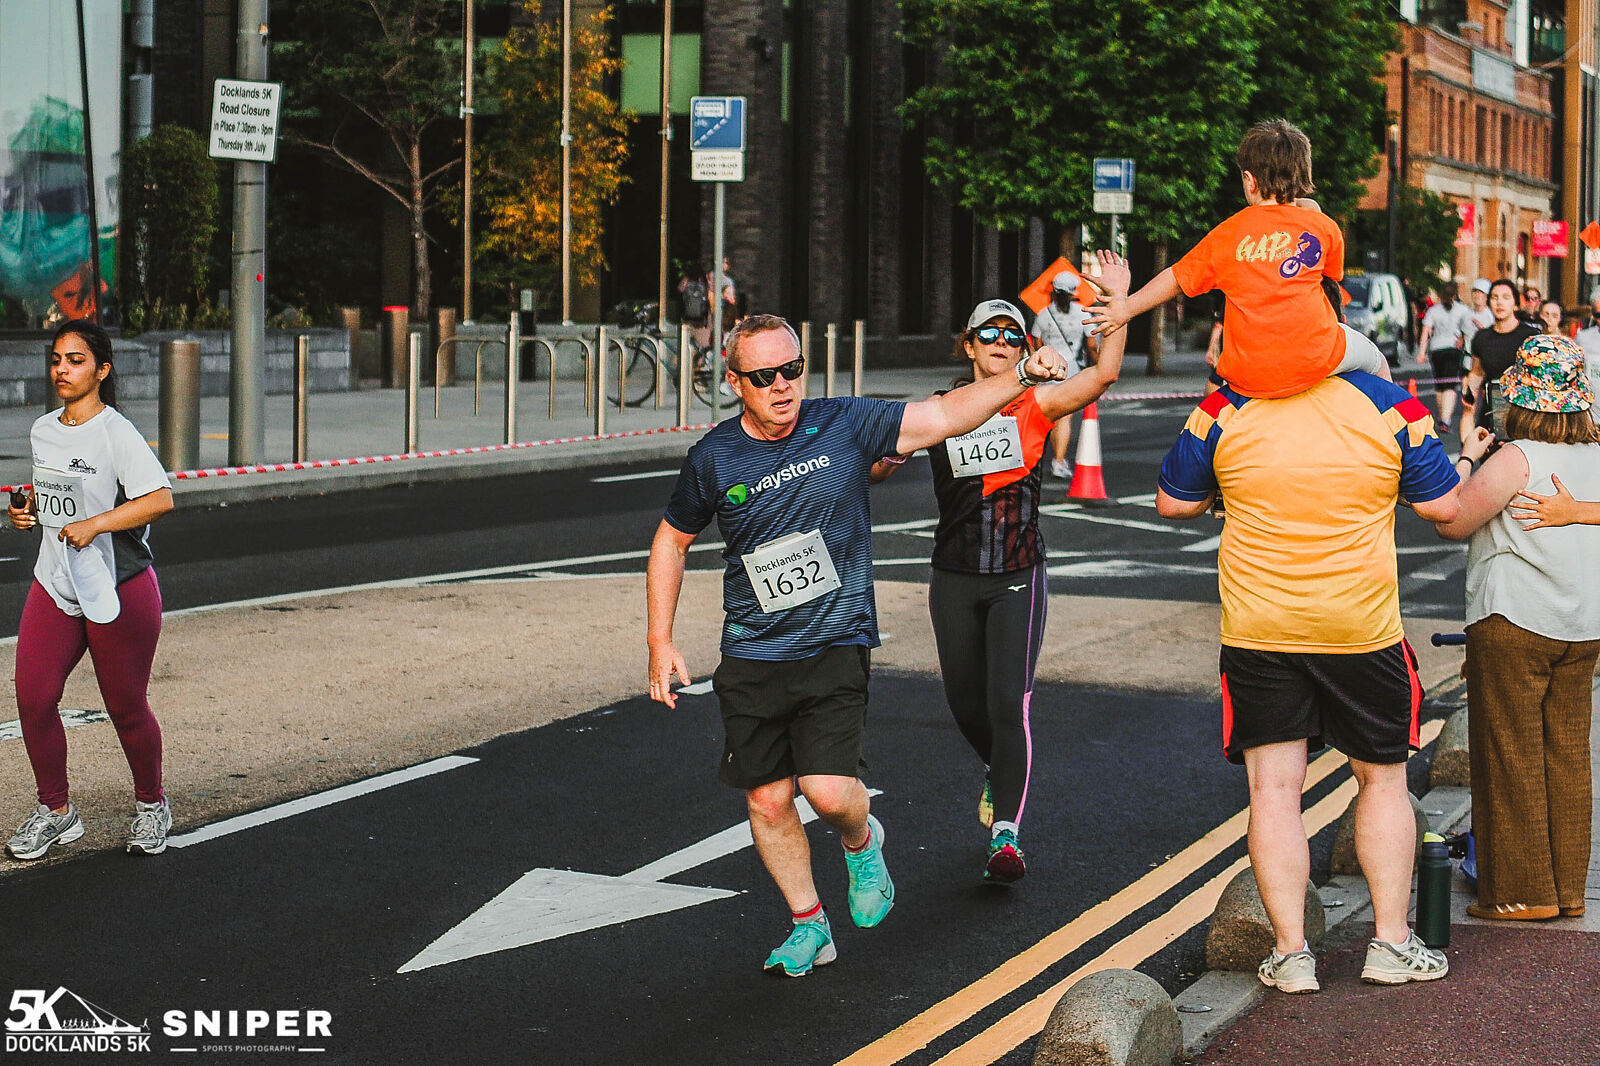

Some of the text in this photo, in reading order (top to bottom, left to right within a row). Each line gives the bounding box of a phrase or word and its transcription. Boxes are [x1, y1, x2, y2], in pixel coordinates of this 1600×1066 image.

[221, 85, 272, 100] Docklands 5K
[219, 102, 270, 117] Road Closure
[220, 120, 235, 133] Place
[261, 124, 273, 137] 9pm
[218, 138, 267, 155] Thursday 9th July
[1235, 231, 1292, 262] GAP
[955, 426, 1009, 442] Docklands 5K
[957, 438, 1013, 466] 1462
[34, 478, 74, 492] Docklands 5K
[35, 492, 77, 517] 1700
[754, 545, 816, 574] Docklands 5K
[762, 560, 826, 600] 1632
